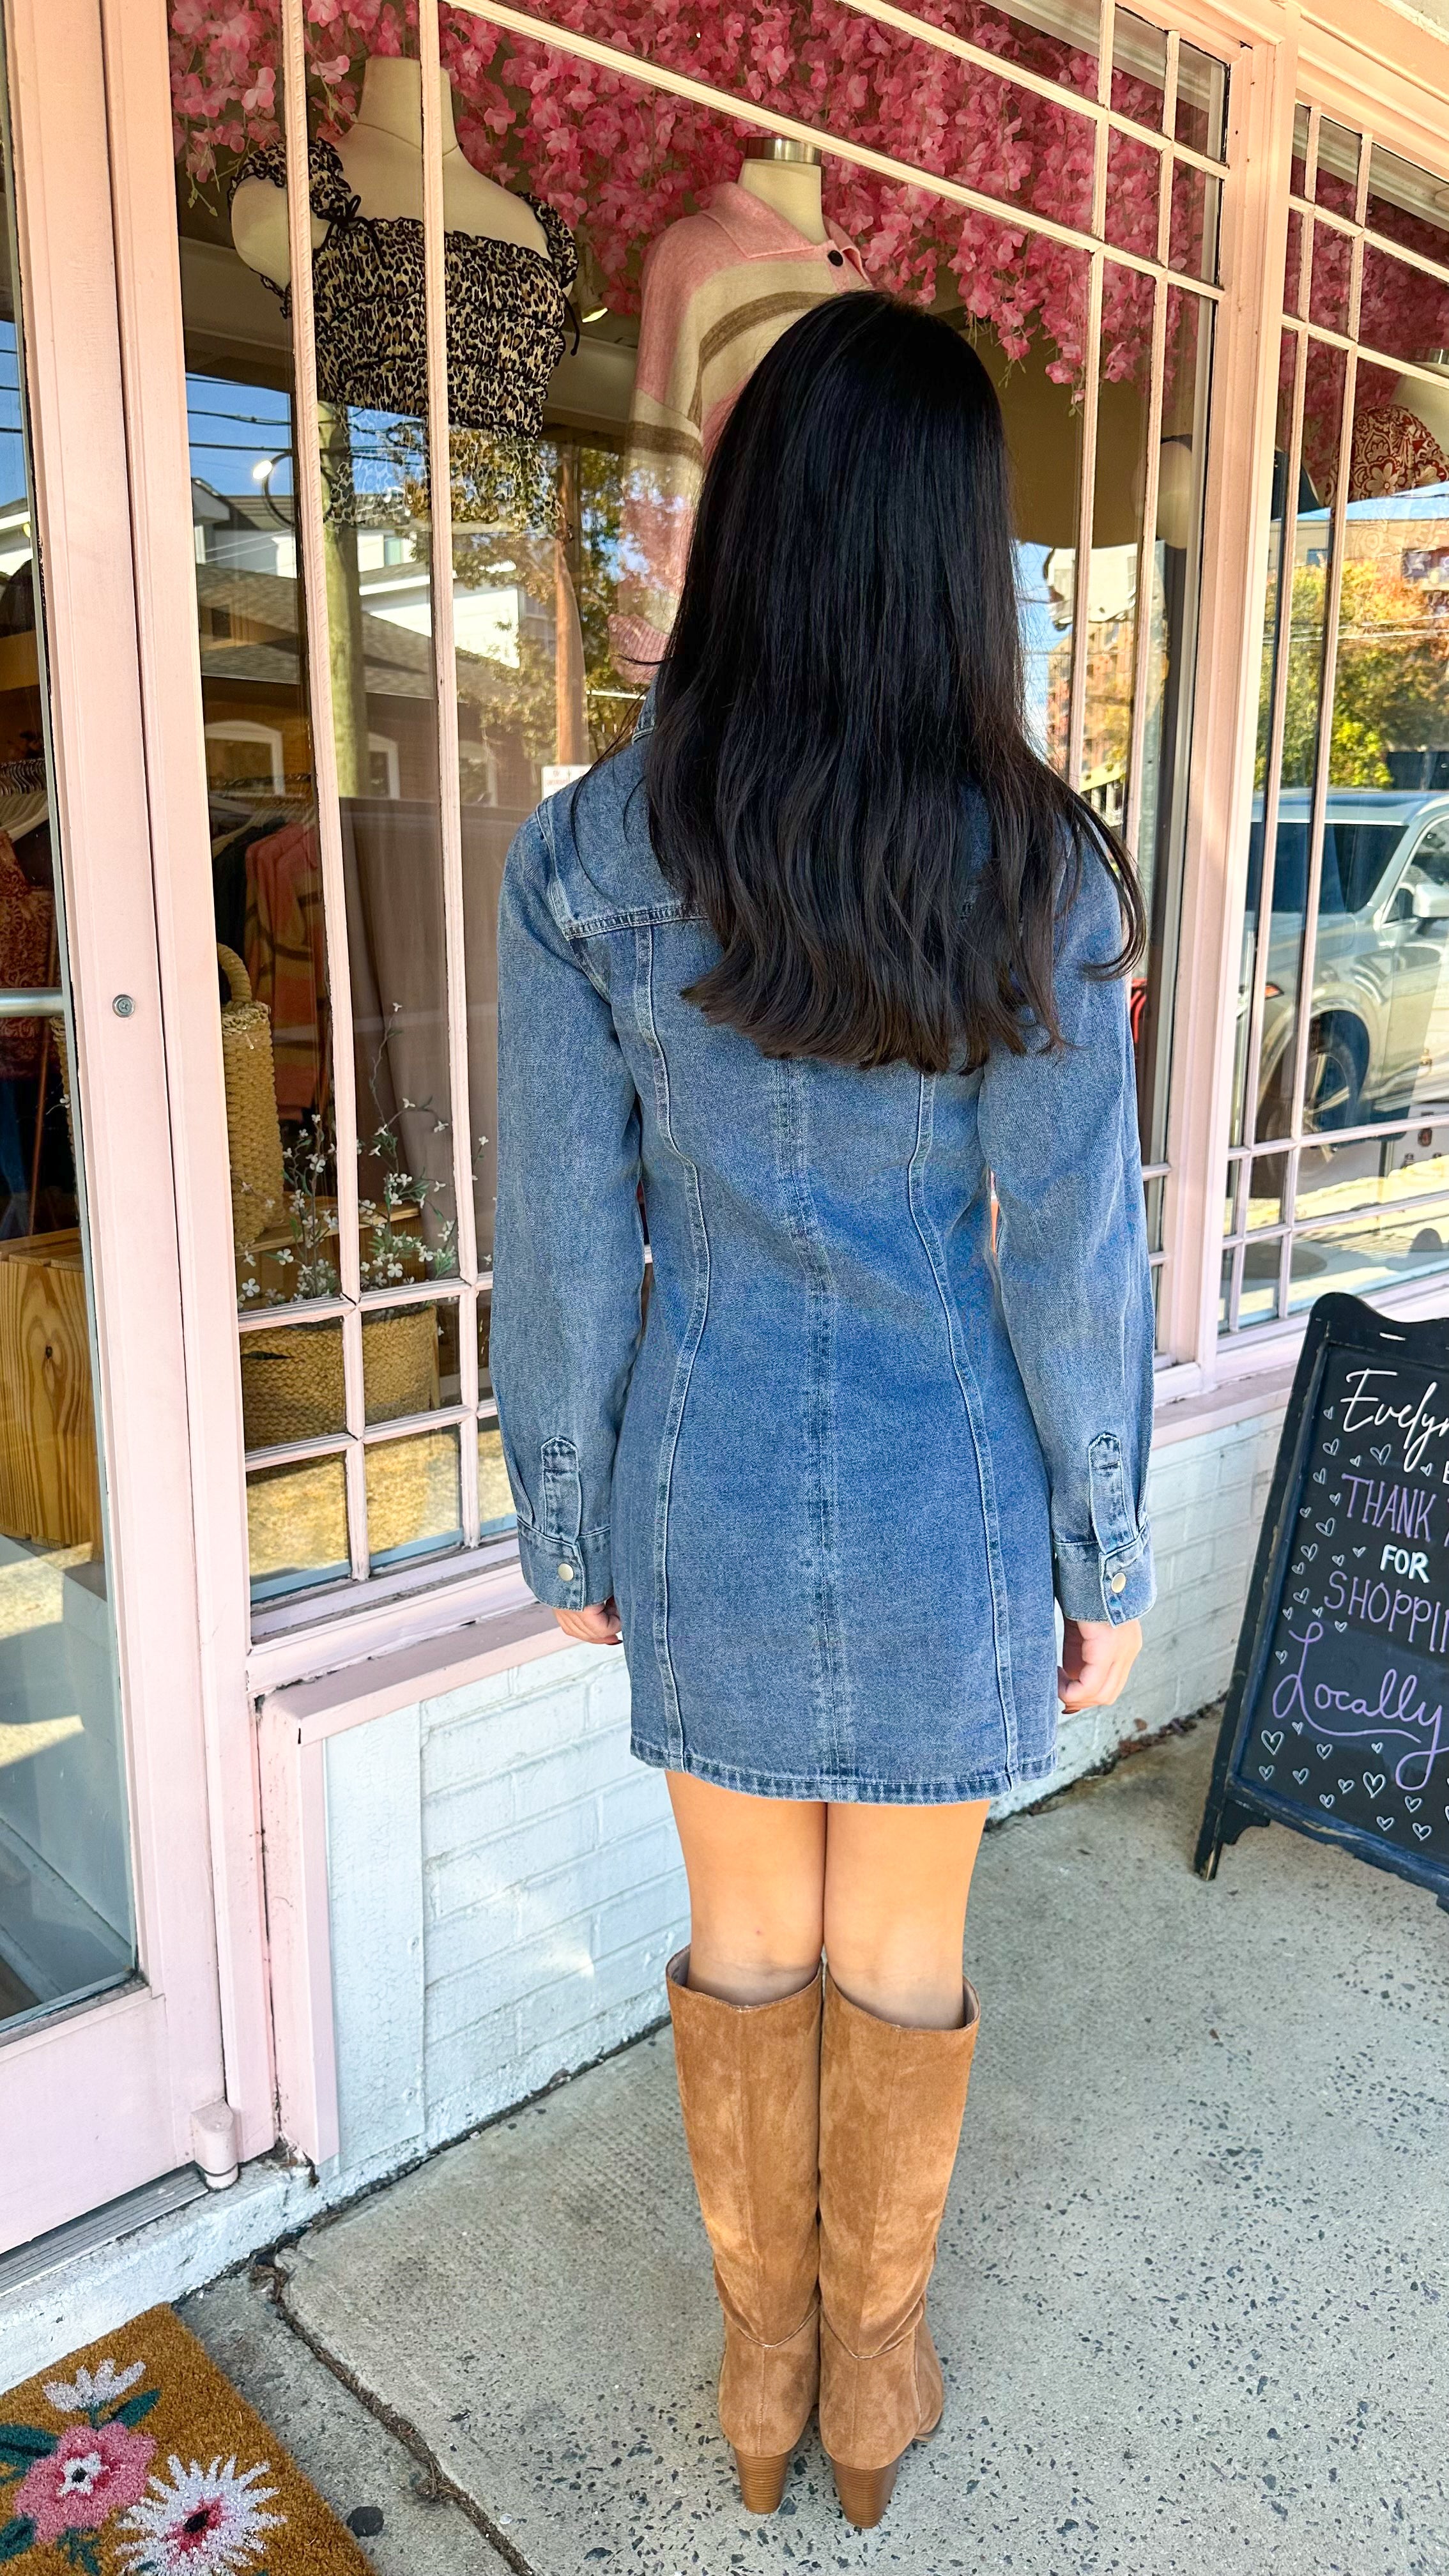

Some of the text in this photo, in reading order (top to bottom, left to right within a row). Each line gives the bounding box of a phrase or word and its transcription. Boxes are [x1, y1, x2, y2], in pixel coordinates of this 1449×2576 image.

[1341, 1473, 1437, 1542] THANK
[1380, 1544, 1430, 1584] FOR
[1272, 1621, 1449, 1791] Locally
